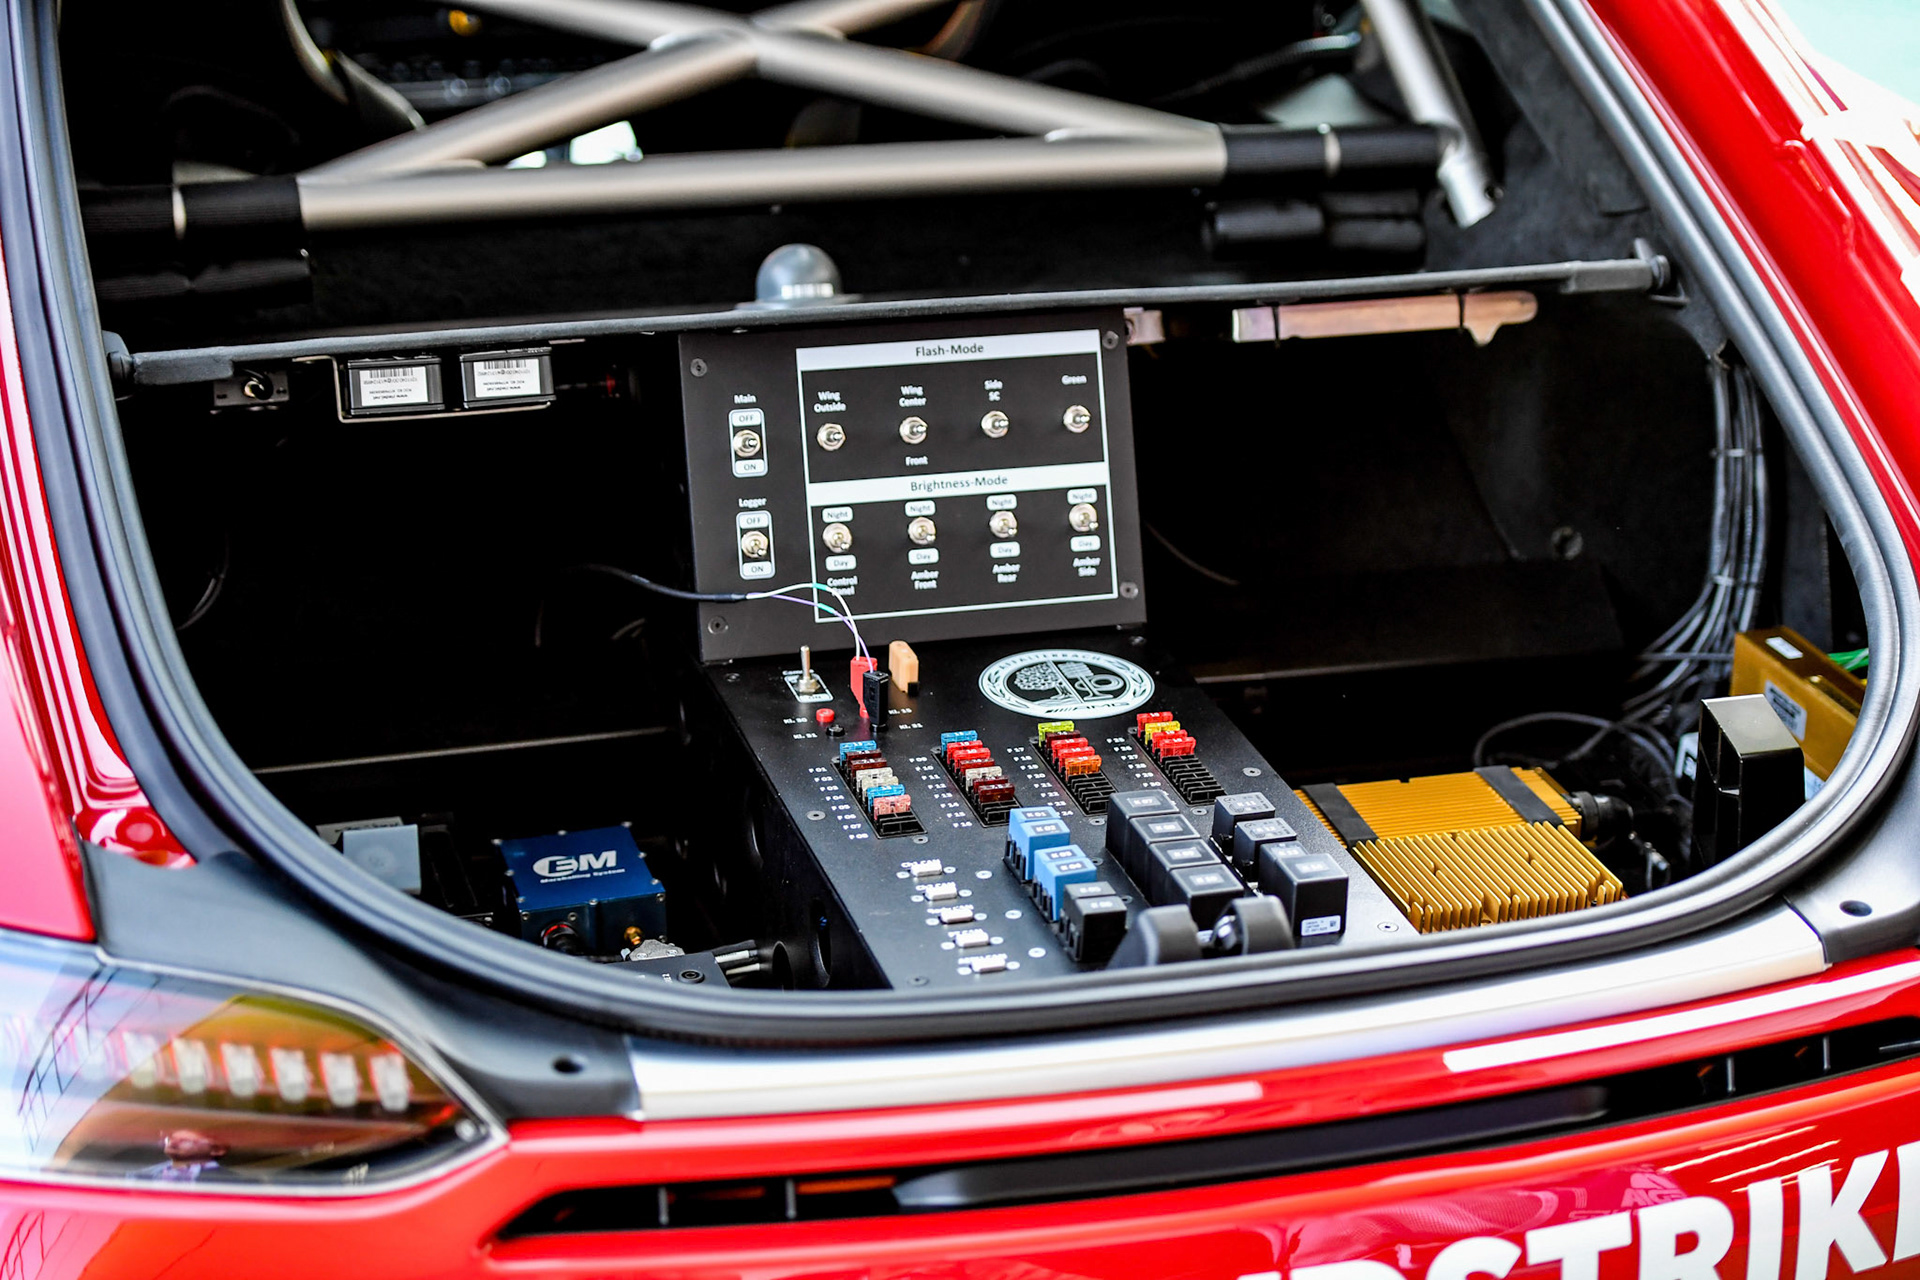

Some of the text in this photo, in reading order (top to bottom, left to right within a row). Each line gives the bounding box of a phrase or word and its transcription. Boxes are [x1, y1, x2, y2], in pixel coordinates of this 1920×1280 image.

[915, 344, 984, 357] Flash-Mode
[984, 379, 1003, 391] Side
[1061, 374, 1088, 386] Green
[900, 385, 924, 396] Wing
[734, 394, 757, 404] Main
[818, 391, 840, 402] Wing
[988, 391, 1000, 402] SC
[898, 397, 927, 407] Center
[814, 402, 846, 413] Outside
[905, 456, 928, 466] Front
[744, 463, 756, 471] ON
[910, 475, 1008, 492] Brightness-Mode
[1072, 492, 1093, 501] Night
[738, 498, 768, 508] Logger
[991, 498, 1013, 508] Night
[910, 504, 931, 514] Night
[827, 511, 848, 520] Night
[998, 546, 1012, 554] Day
[916, 553, 931, 562] Day
[833, 559, 848, 567] Day
[826, 575, 858, 586] Control
[592, 868, 626, 876] System
